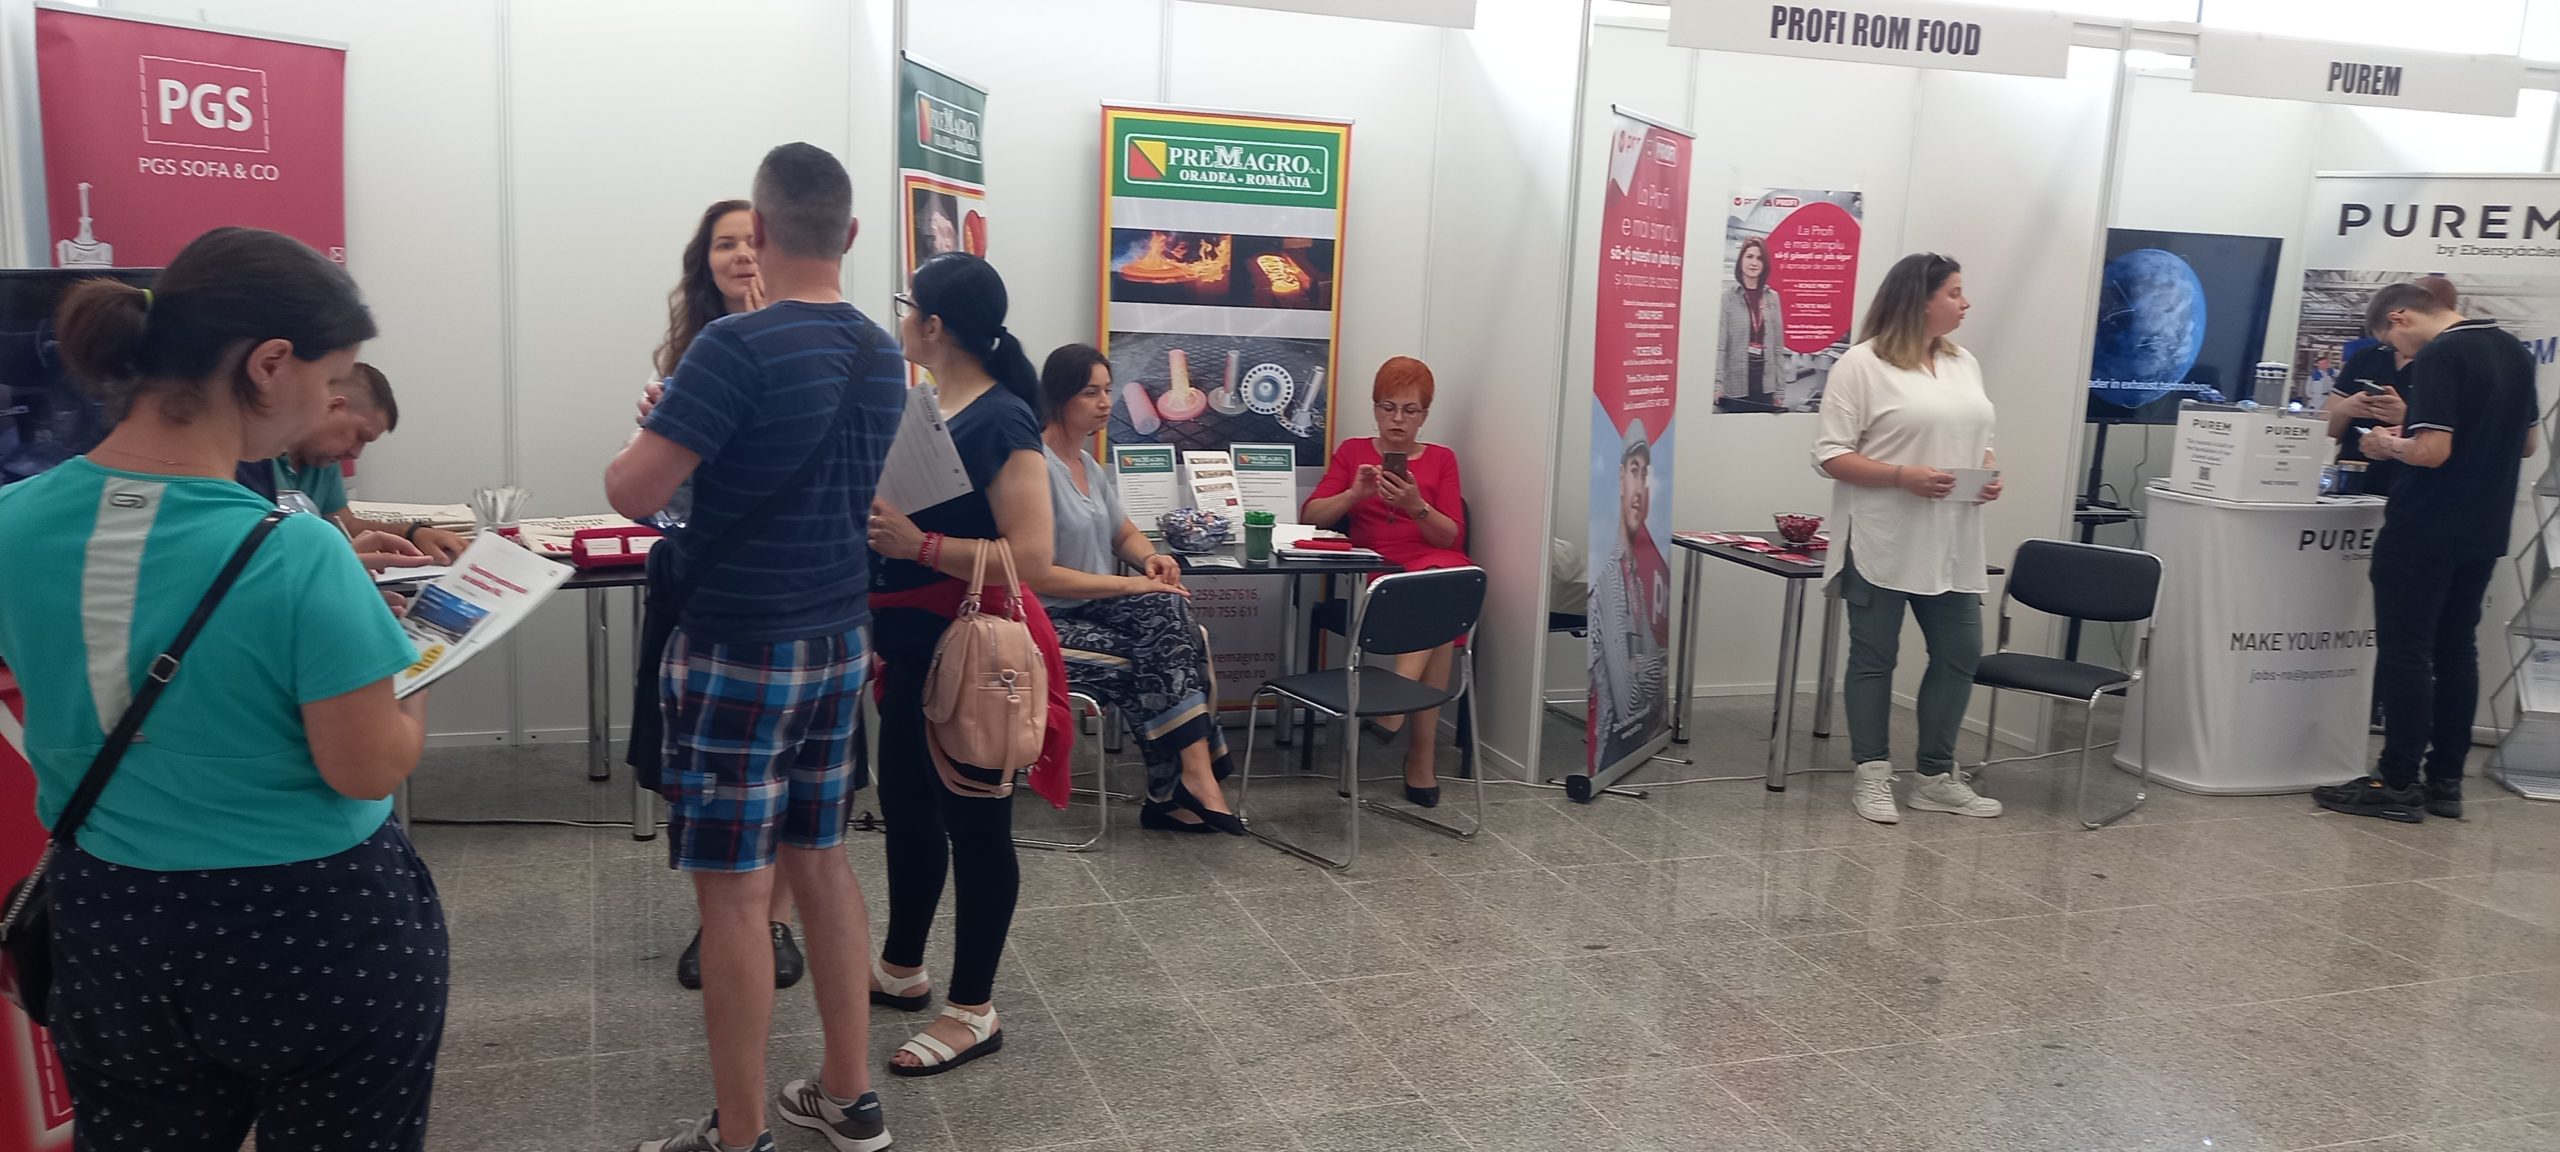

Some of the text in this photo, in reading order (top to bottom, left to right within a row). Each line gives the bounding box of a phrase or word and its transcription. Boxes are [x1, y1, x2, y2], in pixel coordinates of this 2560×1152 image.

[1769, 4, 1982, 56] PROFI ROM FOOD
[2326, 61, 2403, 96] PUREM
[157, 77, 254, 132] PGS
[138, 156, 280, 181] PGS SOFA & CO
[1167, 145, 1311, 175] PREMAGRO
[1179, 169, 1236, 184] ORADEA
[1245, 172, 1311, 188] ROMÂNIA
[1622, 218, 1631, 236] e
[1797, 225, 1834, 236] La Profi
[2337, 202, 2560, 240] PUREM
[1784, 239, 1845, 251] e mai simplu
[2436, 244, 2458, 257] by
[2121, 379, 2158, 390] exhaust
[2192, 418, 2232, 431] PUREM
[2265, 425, 2310, 436] PUREM
[2298, 528, 2375, 551] PURE
[2230, 629, 2376, 651] MAKE YOUR MOVE
